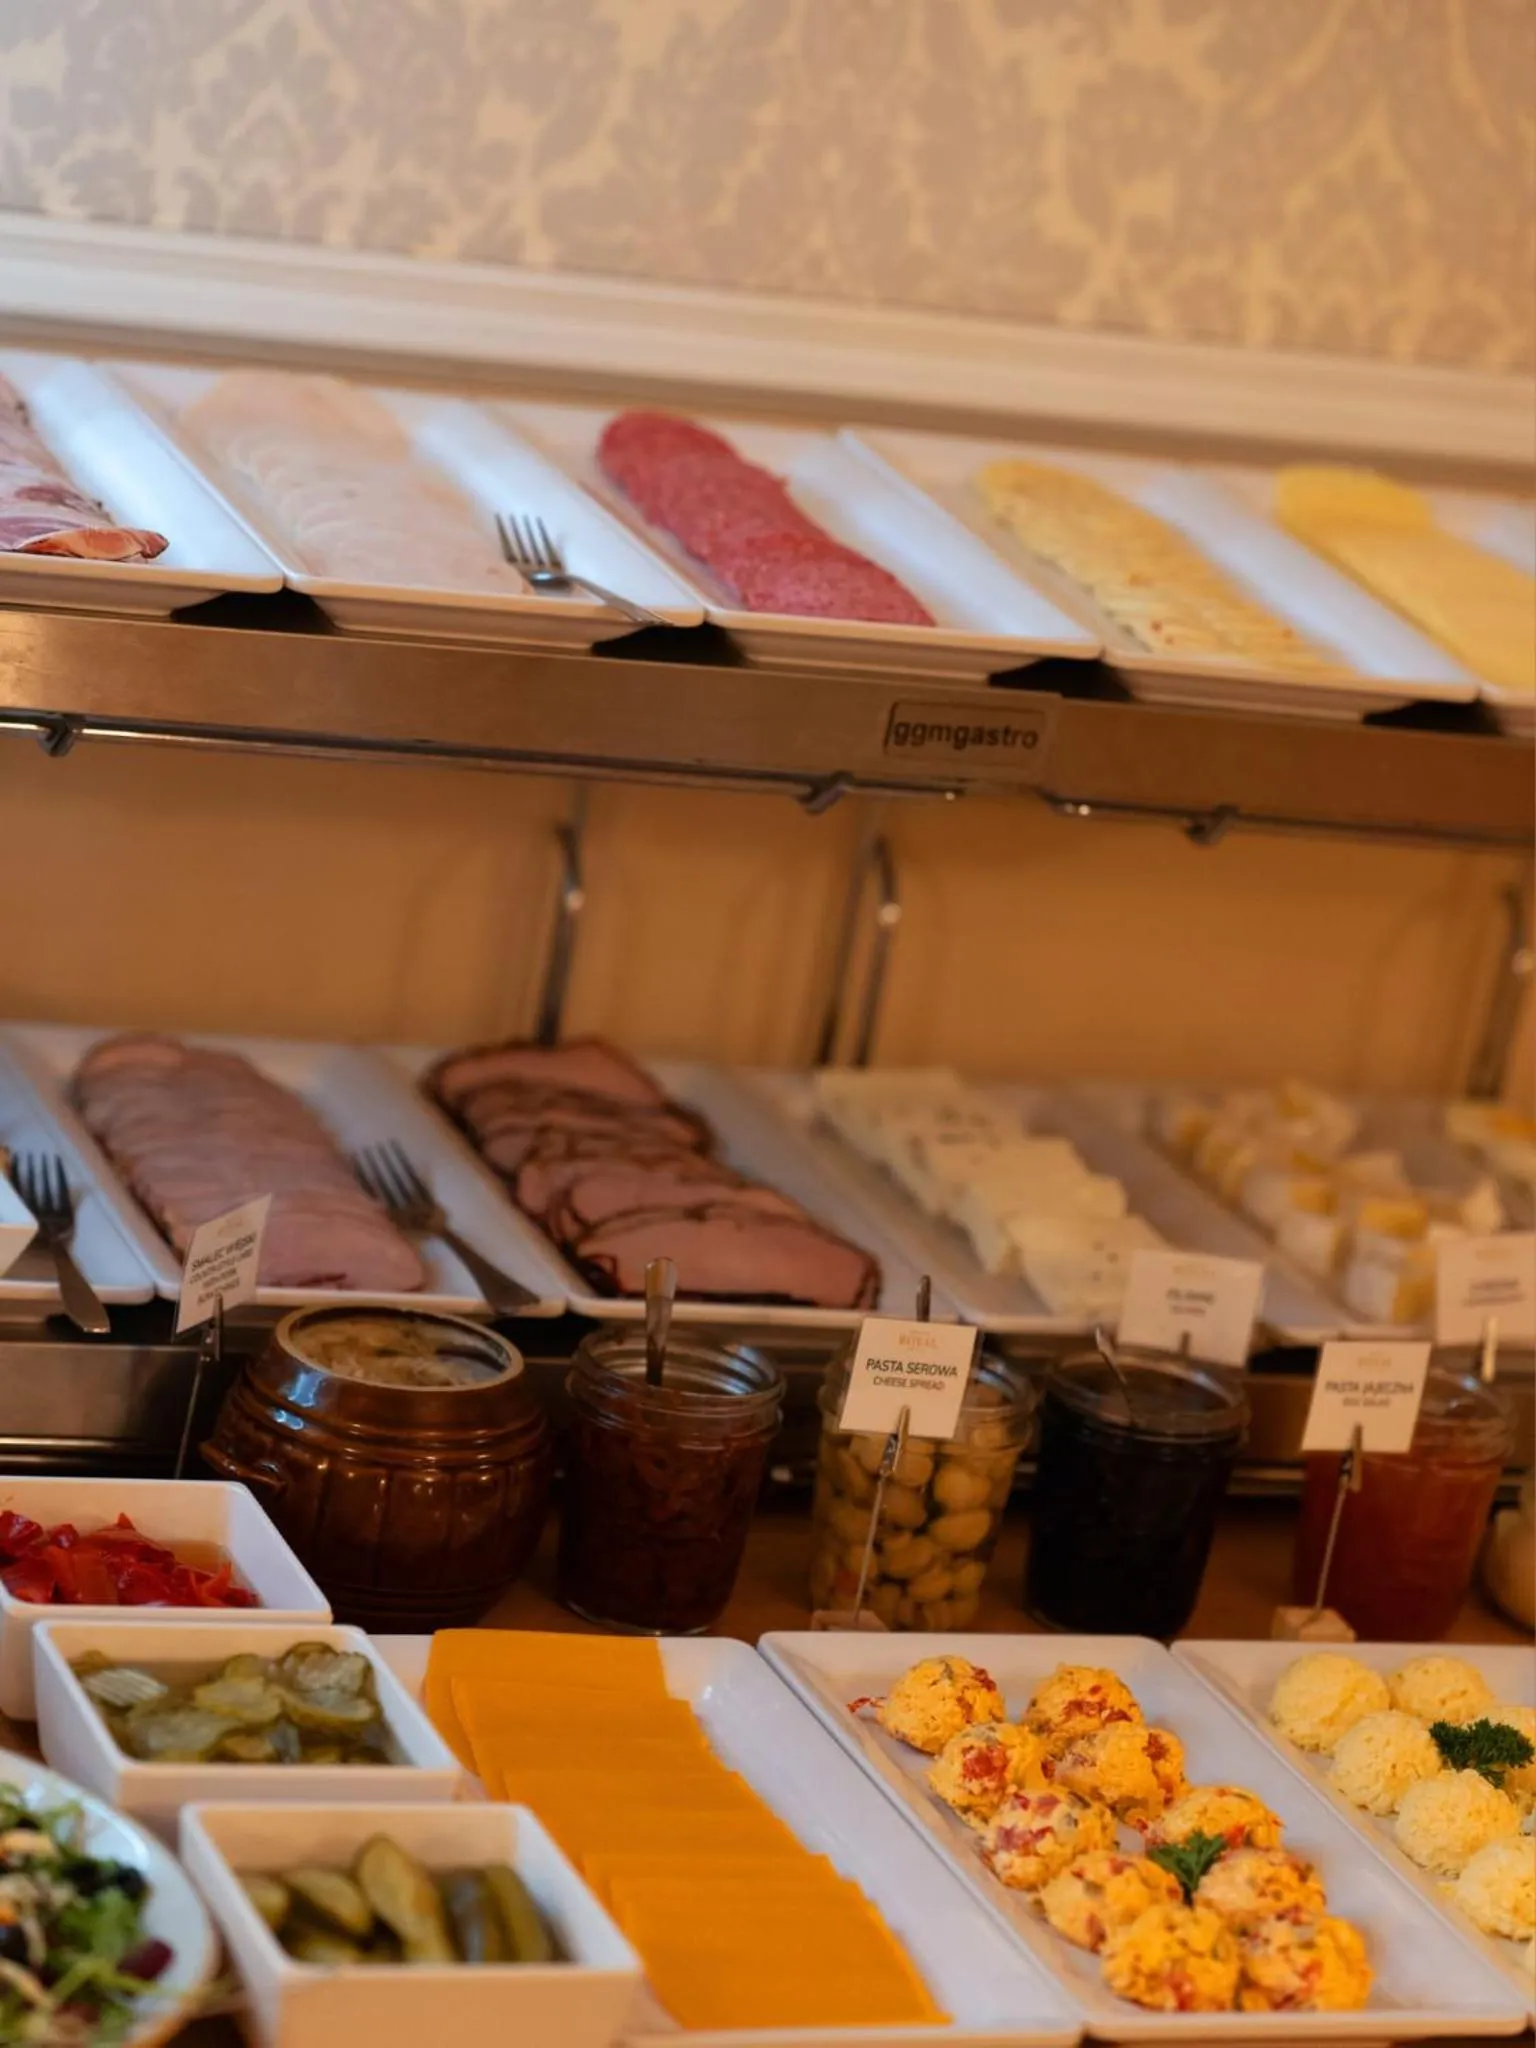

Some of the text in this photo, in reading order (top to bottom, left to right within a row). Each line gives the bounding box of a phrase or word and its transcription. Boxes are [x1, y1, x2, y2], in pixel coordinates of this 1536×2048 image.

[893, 721, 1039, 751] ggmgastro
[865, 1357, 958, 1377] PASTA SEROWA
[873, 1376, 907, 1388] CHEESE
